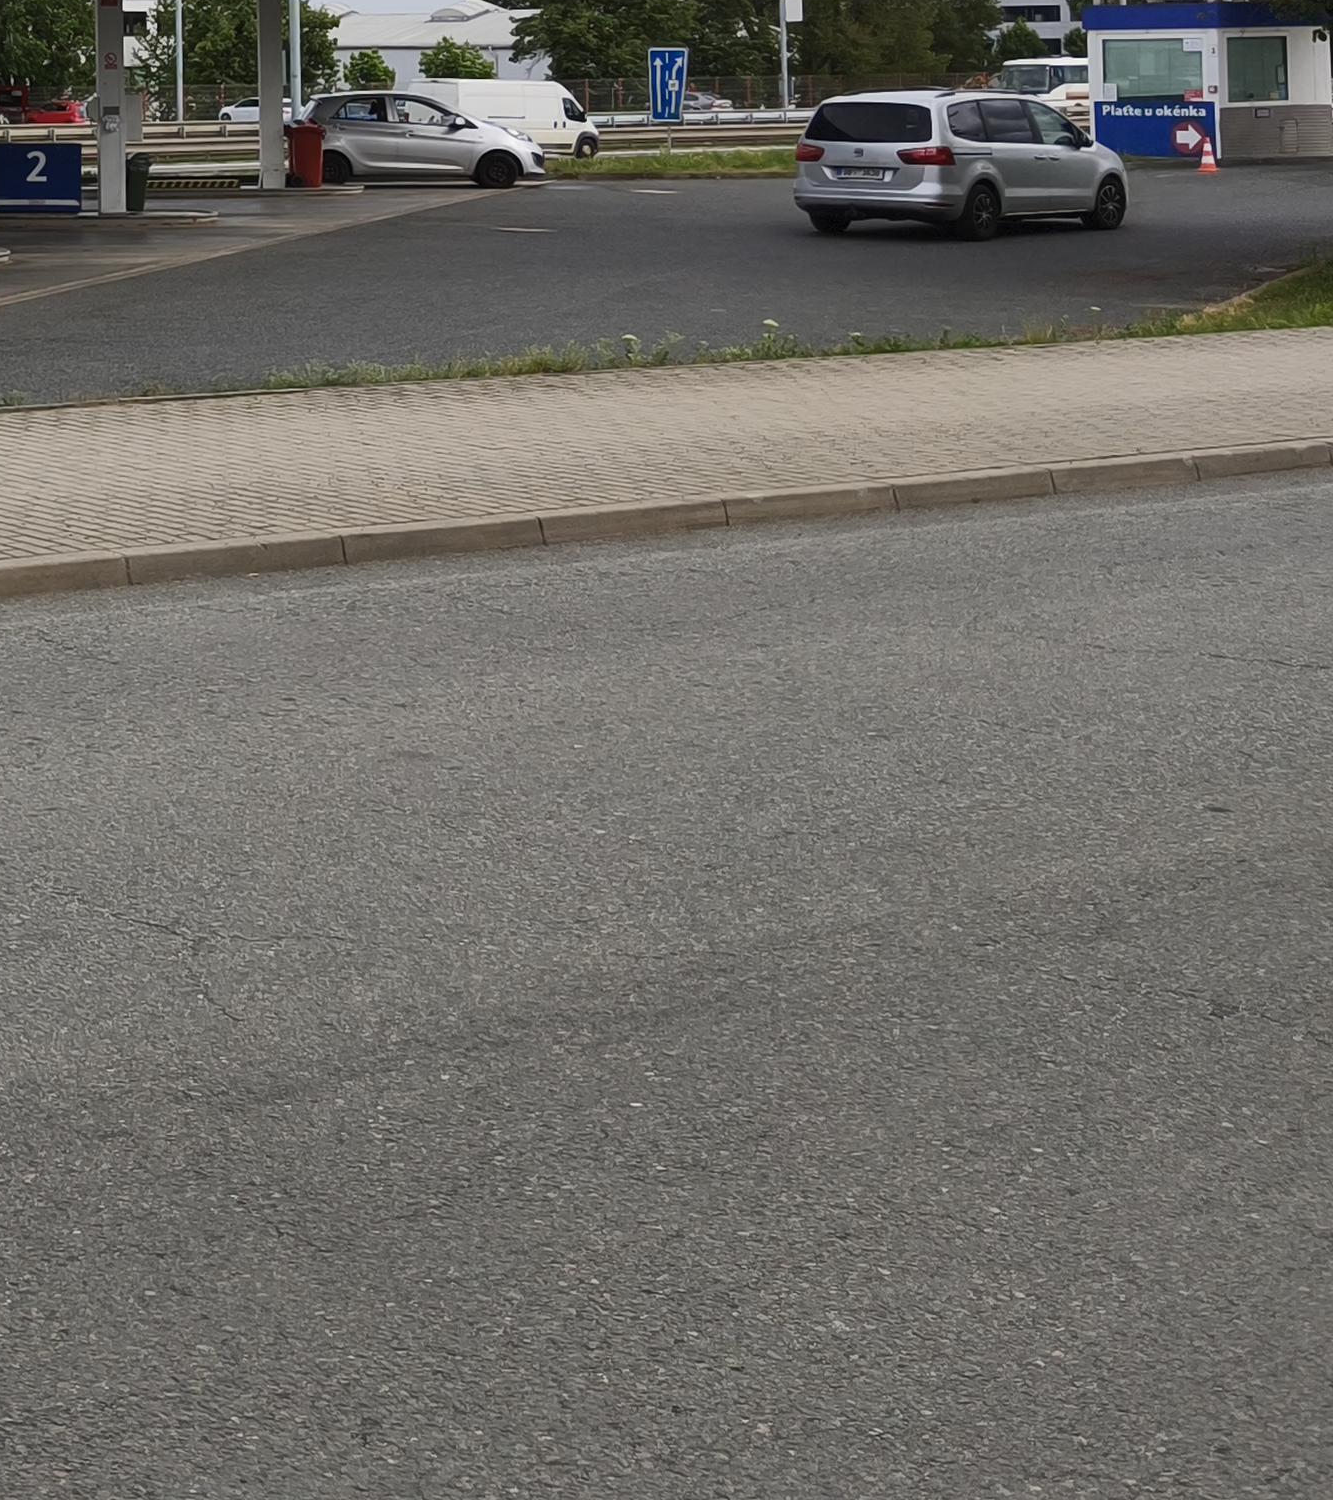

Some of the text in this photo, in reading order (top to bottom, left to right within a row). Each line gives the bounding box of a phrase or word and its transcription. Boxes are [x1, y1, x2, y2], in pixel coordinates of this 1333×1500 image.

[1102, 105, 1207, 117] Plaťte u okénka
[26, 150, 48, 182] 2
